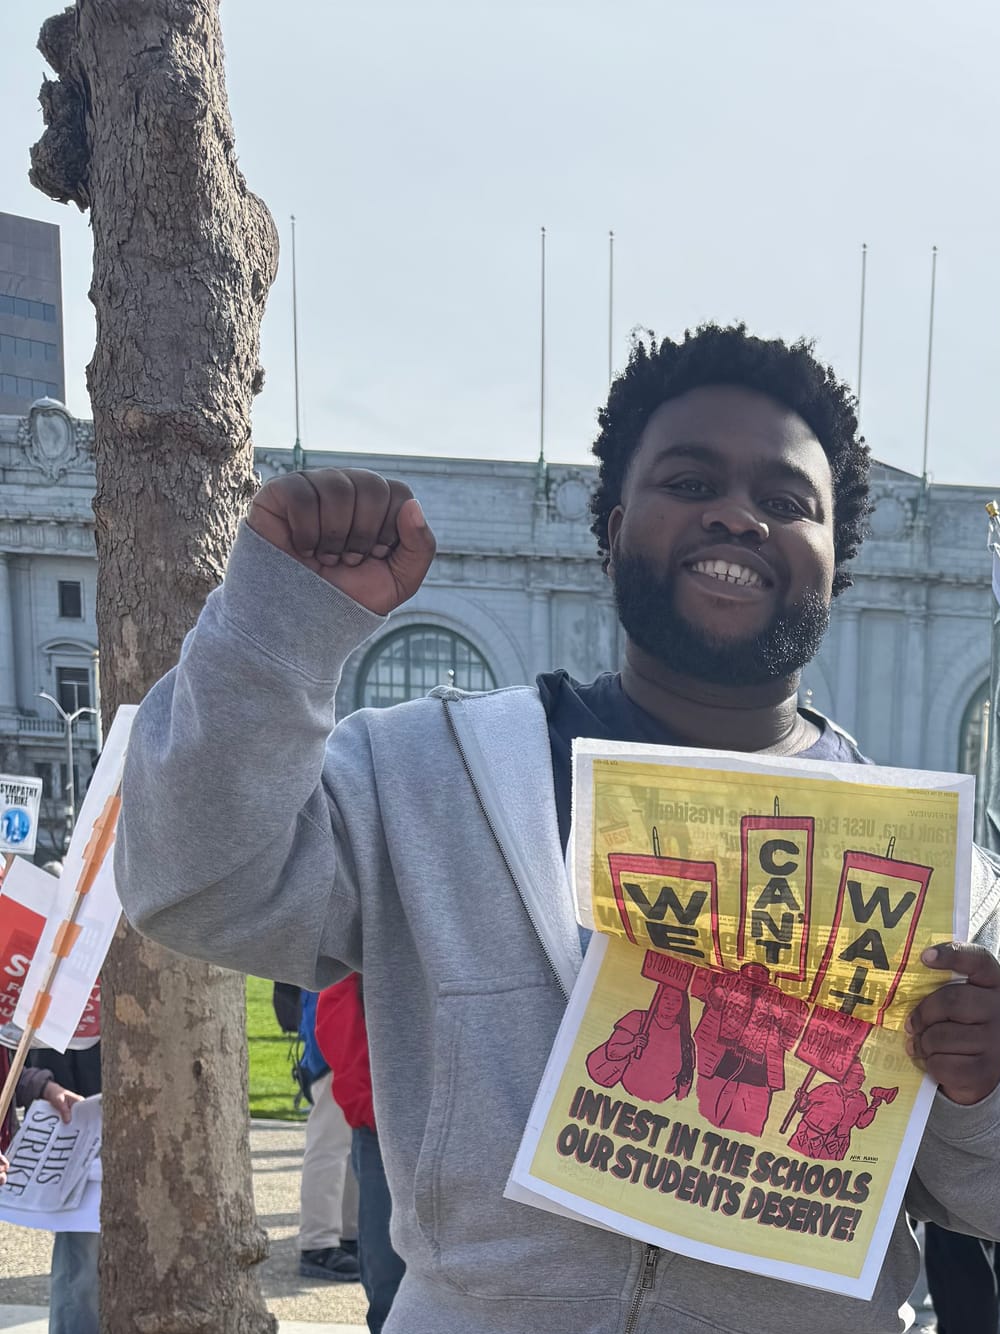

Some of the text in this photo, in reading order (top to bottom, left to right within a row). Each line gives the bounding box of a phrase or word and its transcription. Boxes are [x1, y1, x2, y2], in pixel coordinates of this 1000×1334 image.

[0, 784, 38, 798] SYMPATHY
[622, 882, 707, 958] WE
[829, 879, 917, 1014] WAIT
[645, 951, 689, 982] STUDENTS
[0, 1111, 60, 1197] STRIKE
[36, 1129, 80, 1185] THIS
[555, 1123, 862, 1242] OUR STUDENTS DESERVE!
[569, 1087, 873, 1205] INVEST IN THE SCHOOLS
